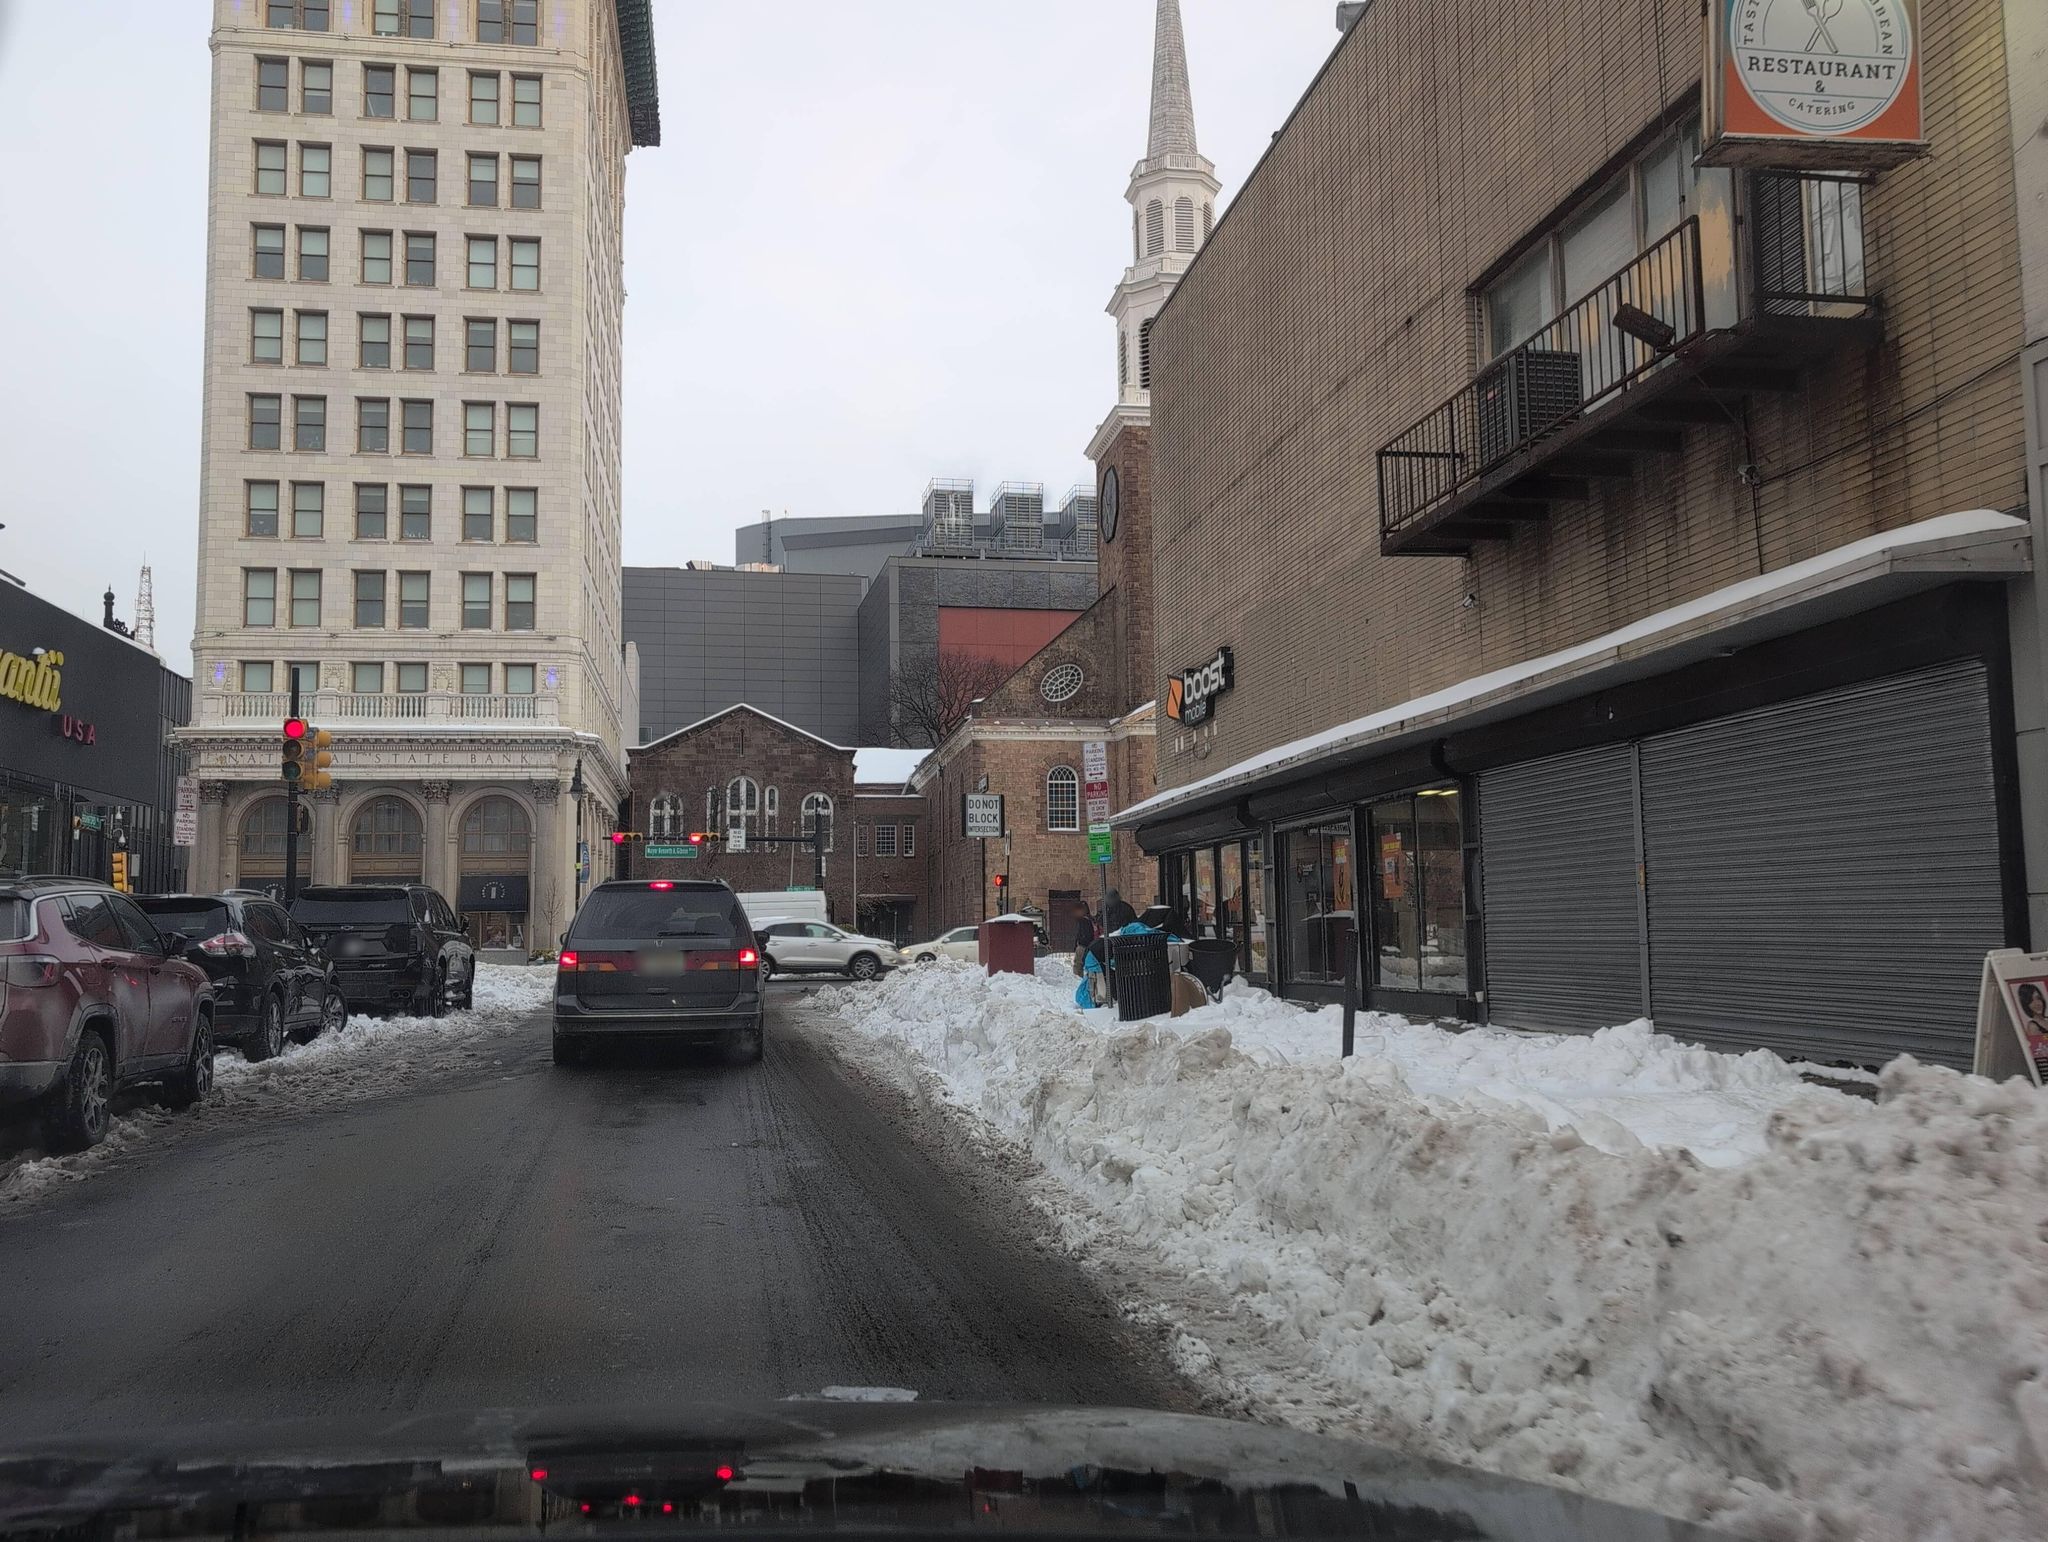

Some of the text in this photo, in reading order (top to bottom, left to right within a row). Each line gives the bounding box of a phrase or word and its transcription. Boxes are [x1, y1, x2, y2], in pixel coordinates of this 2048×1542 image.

[1747, 56, 1896, 79] RESTAURANT
[1815, 80, 1825, 92] &
[1788, 97, 1855, 115] CATERING
[1184, 650, 1225, 704] boost
[1185, 700, 1206, 724] mobile
[64, 715, 96, 746] USA
[229, 753, 529, 764] NATAL STATE BANK
[1087, 790, 1107, 798] PARKING
[968, 799, 999, 809] DO NOT
[968, 813, 999, 823] BLOCK
[968, 825, 999, 833] INTERSECTION
